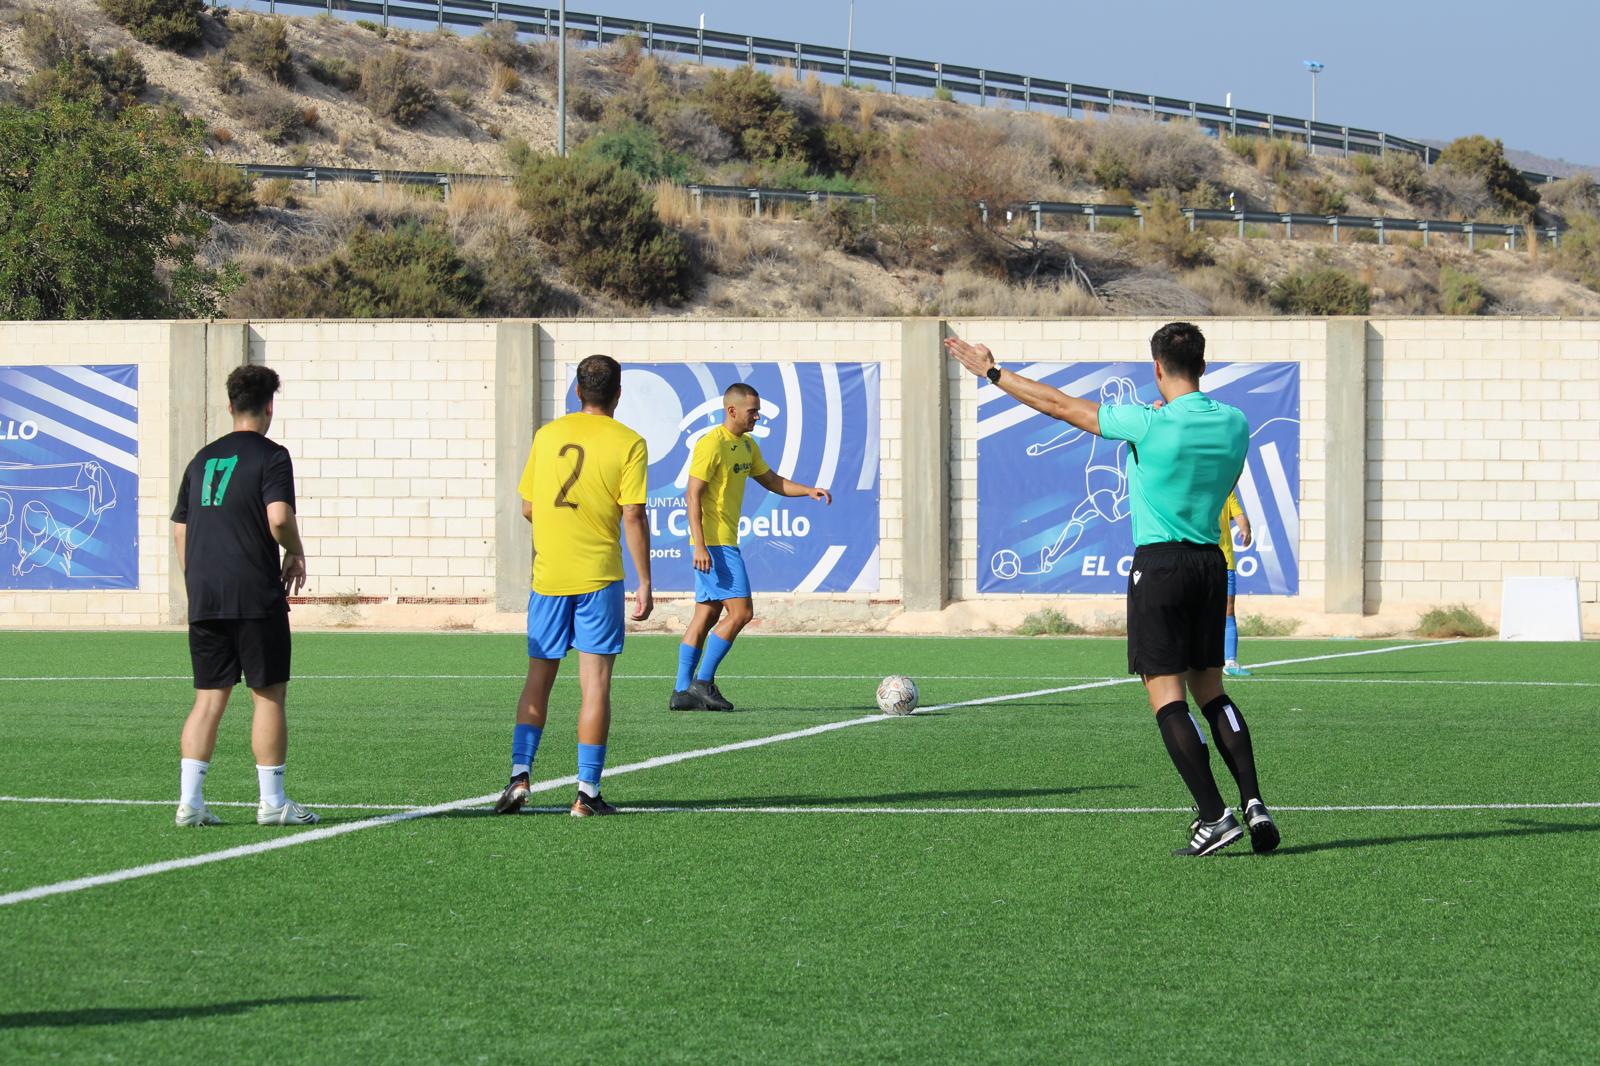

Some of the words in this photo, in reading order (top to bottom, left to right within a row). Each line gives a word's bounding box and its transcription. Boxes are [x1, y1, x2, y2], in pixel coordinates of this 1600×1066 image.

[201, 454, 238, 507] 17
[554, 443, 585, 510] 2
[1081, 555, 1110, 577] EL
